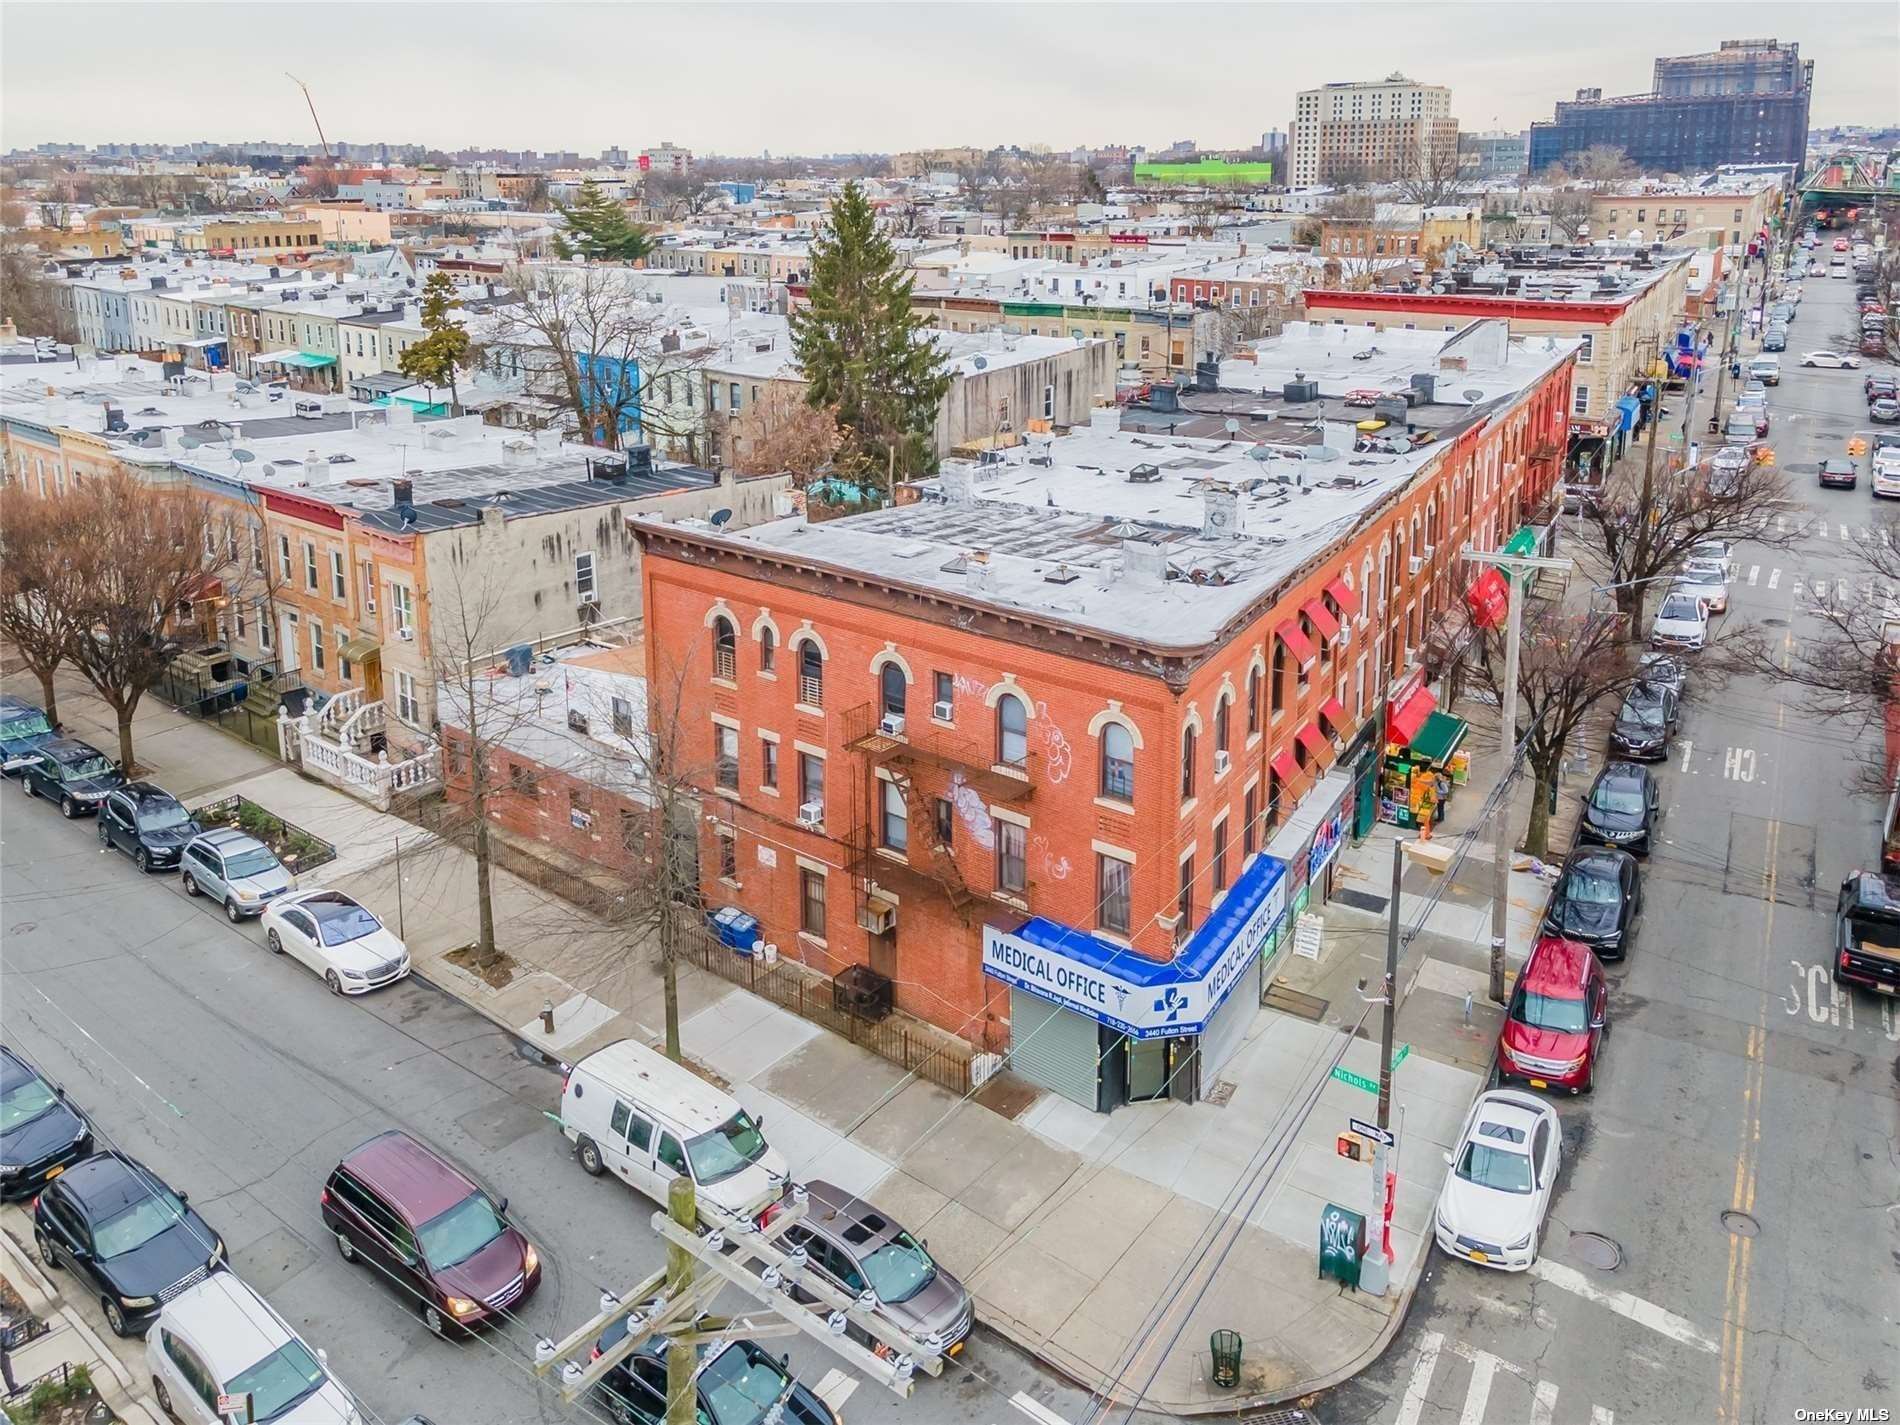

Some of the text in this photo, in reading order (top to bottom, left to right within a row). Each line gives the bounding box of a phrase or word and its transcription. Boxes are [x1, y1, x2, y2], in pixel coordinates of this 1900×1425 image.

[992, 940, 1105, 1004] MEDICAL OFFICE
[1207, 944, 1246, 1003] MEDICAL
[1246, 902, 1272, 948] OFFICE
[1145, 1025, 1198, 1038] 3440 Fulton Street
[1334, 1068, 1367, 1088] Nichols
